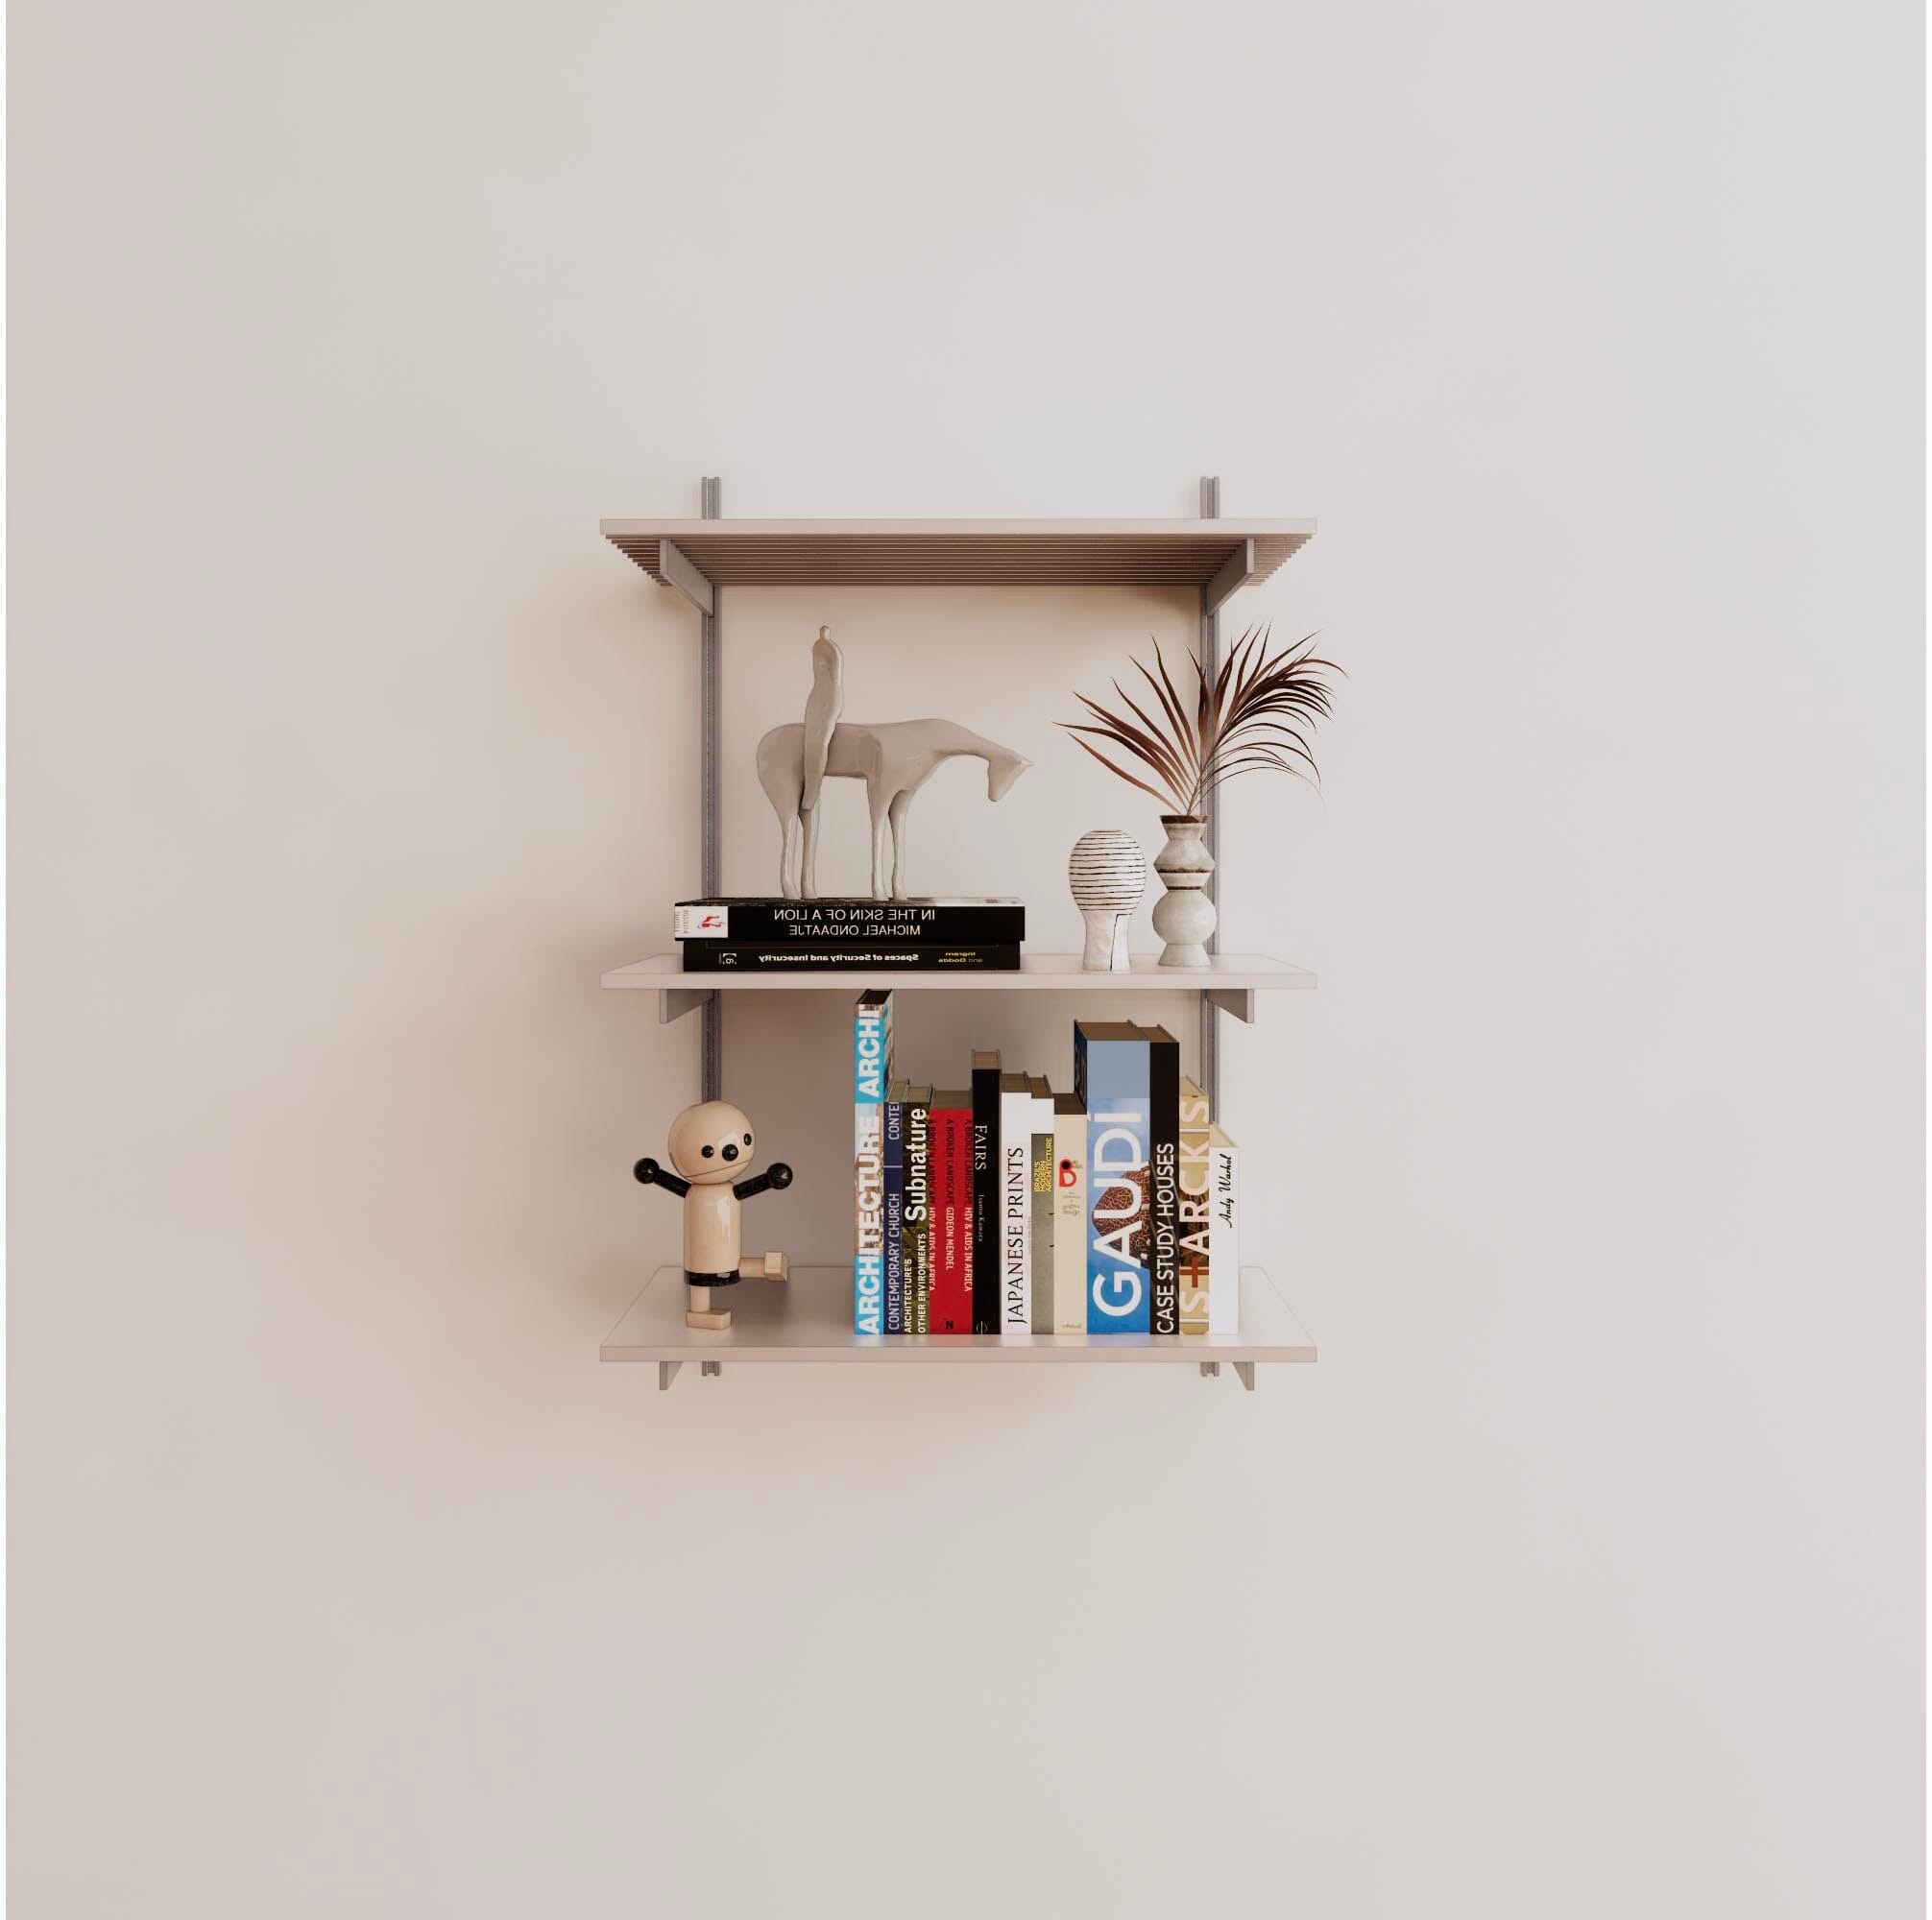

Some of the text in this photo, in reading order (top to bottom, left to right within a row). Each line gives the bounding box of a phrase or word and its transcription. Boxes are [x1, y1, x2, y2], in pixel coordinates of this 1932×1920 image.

[945, 1126, 954, 1157] BROKEN
[975, 1125, 987, 1170] FAIRS
[905, 1108, 928, 1222] Subnature
[945, 1160, 954, 1205] LANDSCAPE
[1219, 1153, 1234, 1229] Andy Warhol
[857, 1116, 881, 1334] ARCHITECTURE
[887, 1101, 900, 1332] CONTEMPORARY CHURCH CONTE
[945, 1207, 954, 1236] GIDEON
[964, 1207, 973, 1221] HIV
[1007, 1147, 1027, 1325] JAPANESE PRINTS
[945, 1238, 954, 1270] MENDEL
[964, 1231, 973, 1250] AIDS
[964, 1252, 973, 1261] IN
[1156, 1142, 1174, 1333] CASE STUDY HOUSES
[904, 1258, 912, 1333] ARCHITECTURE'S
[917, 1233, 927, 1333] OTHER ENVIRONMENTS
[964, 1263, 973, 1292] AFRICA
